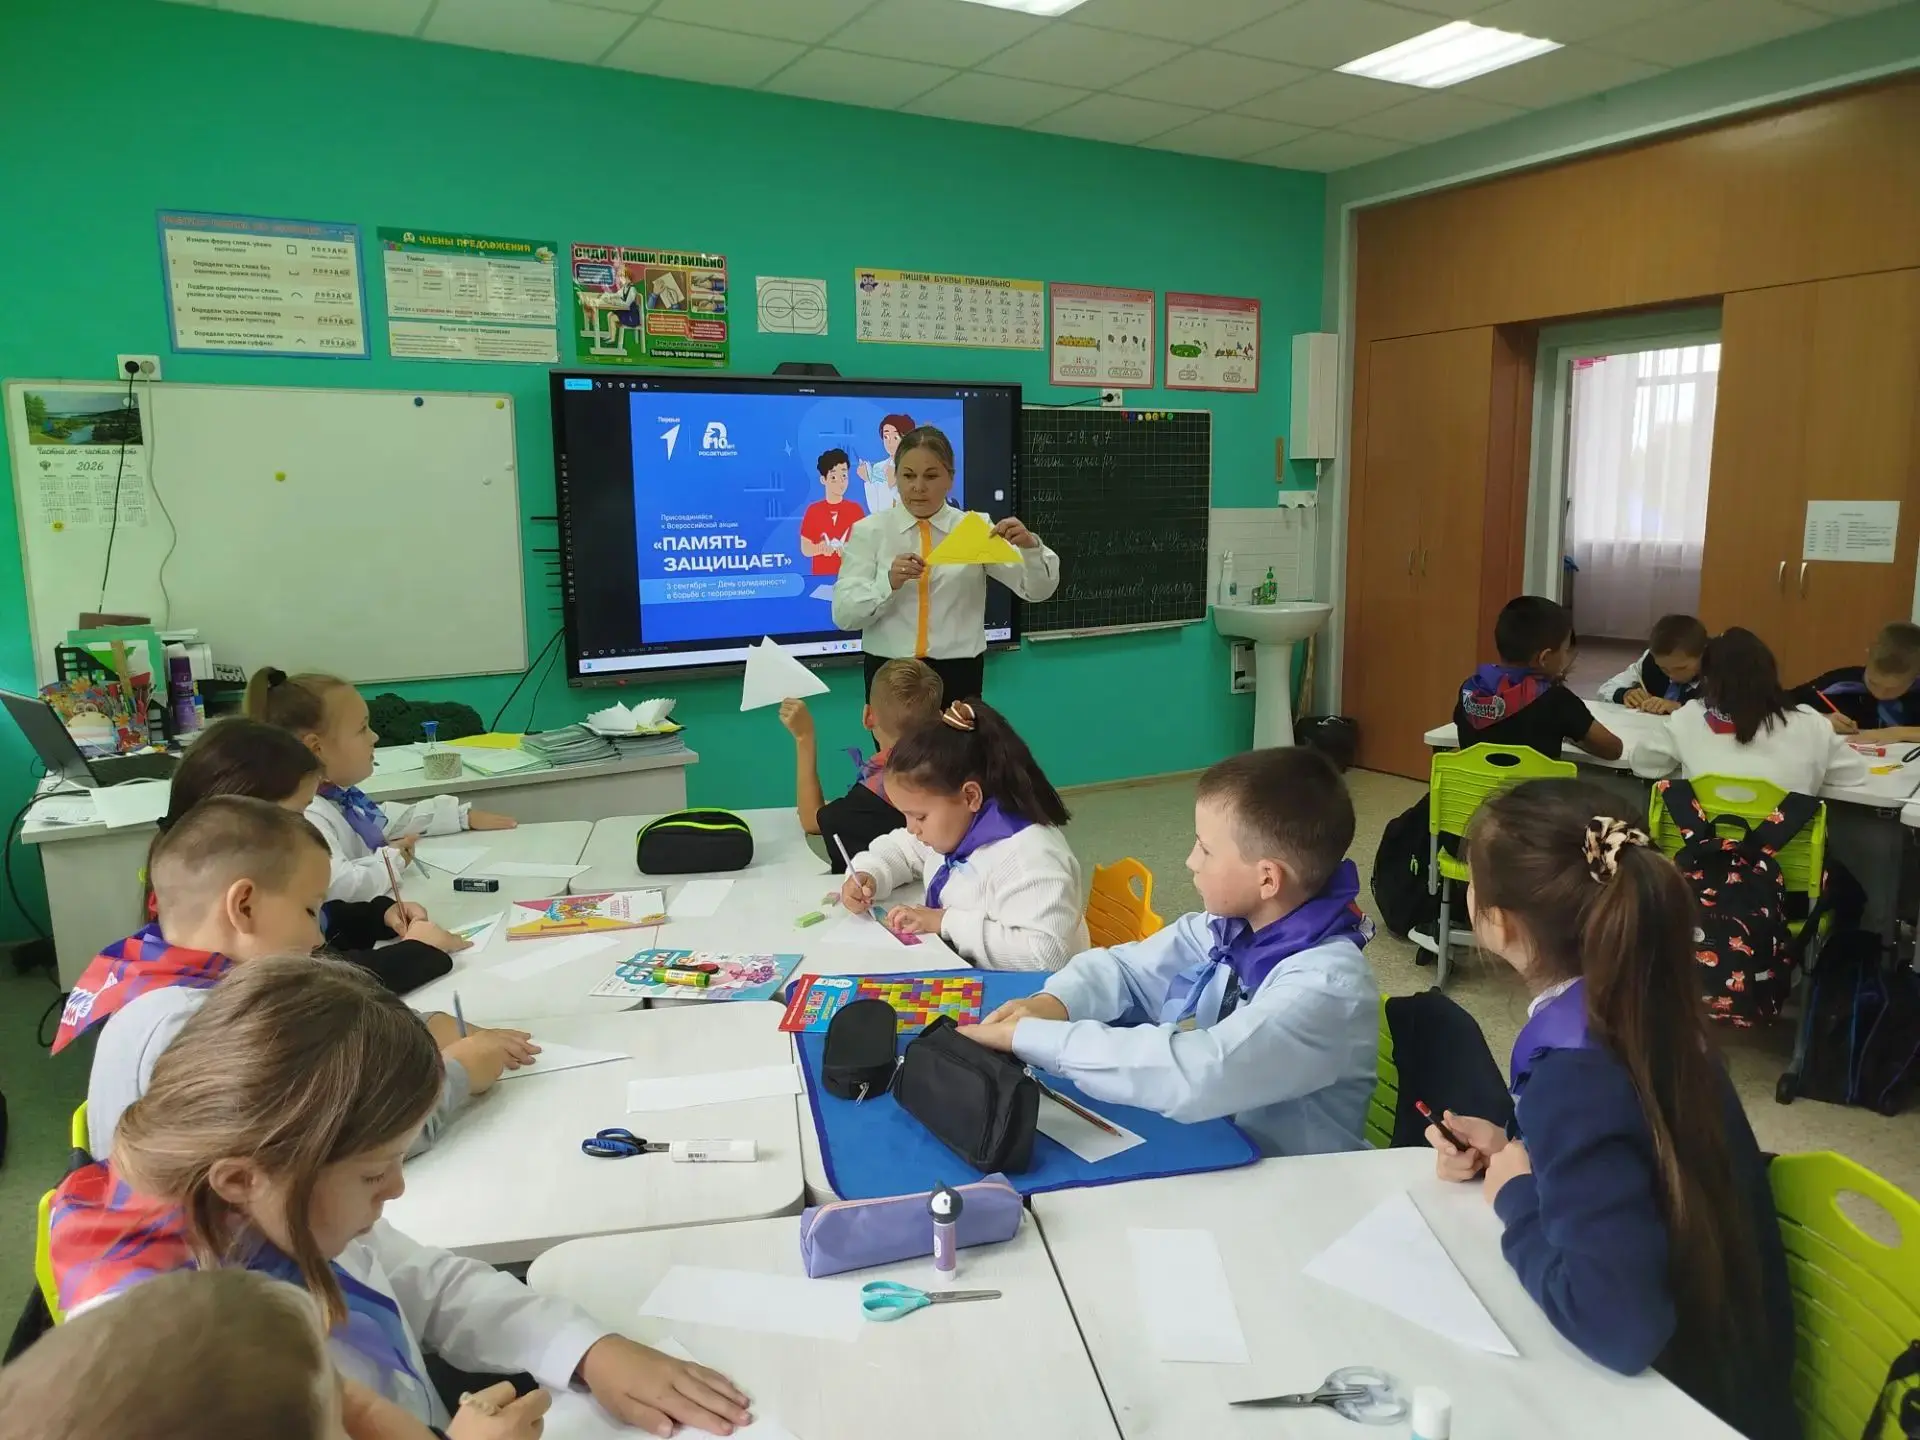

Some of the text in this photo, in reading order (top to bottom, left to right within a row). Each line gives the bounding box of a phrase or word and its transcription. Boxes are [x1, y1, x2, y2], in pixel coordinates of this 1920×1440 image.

[419, 235, 531, 252] ЧЛЕНЫ ПРЕДЛОЖЕНИЯ
[574, 247, 608, 260] СИДИ
[622, 251, 656, 265] ПИШИ
[659, 254, 724, 269] ПРАВИЛЬНО
[900, 272, 1011, 288] ПИШЕМ БУКВЫ ПРАВИЛЬНО
[76, 461, 104, 471] 2026
[666, 522, 718, 530] Всероссийской
[653, 534, 748, 552] «ПАМЯТЬ
[663, 553, 792, 573] ЗАЩИЩАЕТ»
[673, 581, 707, 591] сентября
[717, 580, 736, 589] День
[737, 577, 787, 587] солидарности
[672, 589, 700, 600] борьбе
[708, 588, 756, 598] терроризмом
